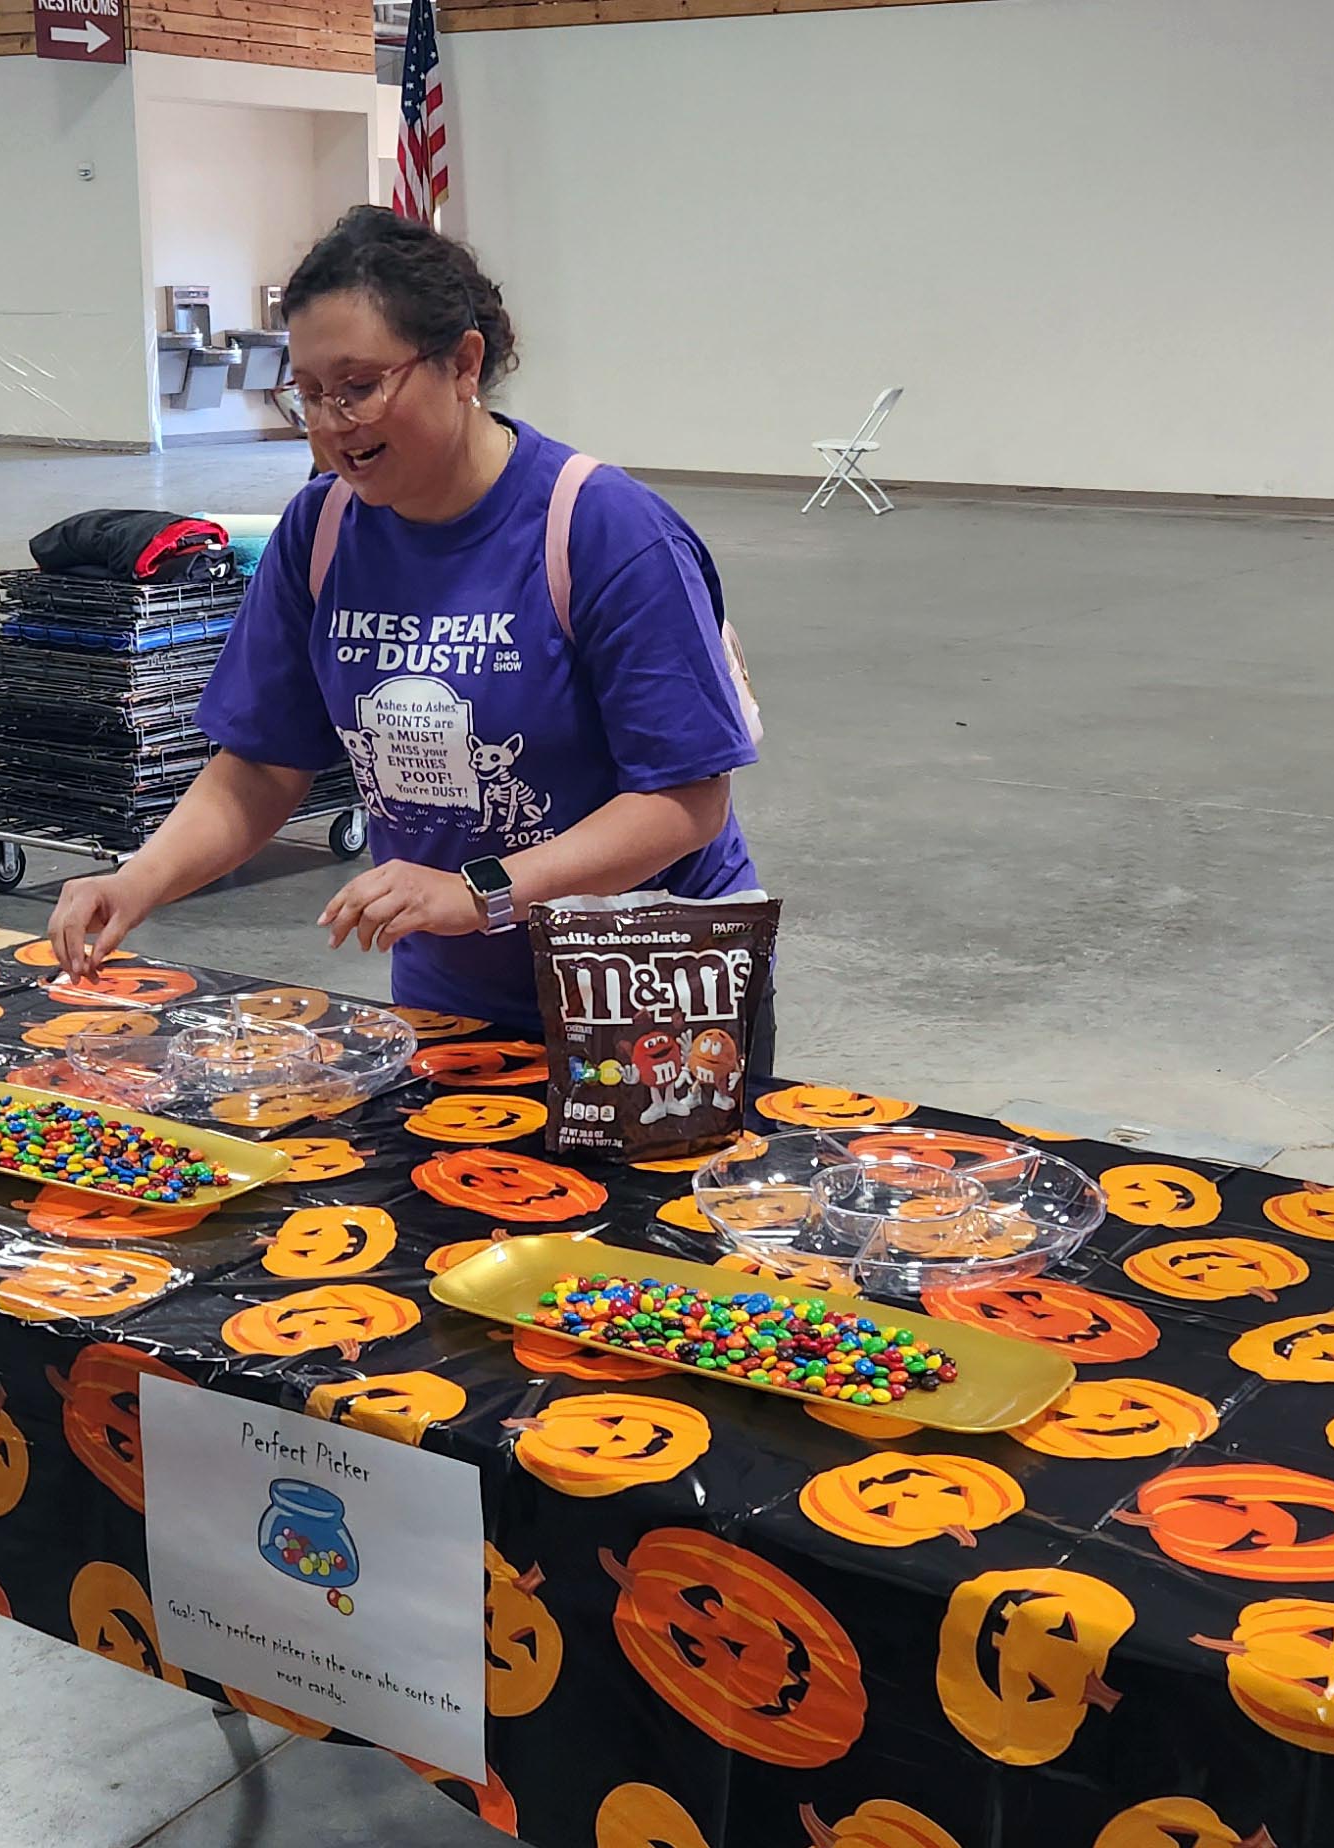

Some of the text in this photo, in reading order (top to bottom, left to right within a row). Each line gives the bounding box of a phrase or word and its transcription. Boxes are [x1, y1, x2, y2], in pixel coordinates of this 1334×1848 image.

[328, 609, 516, 645] IKES PEAK
[337, 642, 486, 675] or DUST!
[492, 661, 523, 672] SHOW
[375, 698, 459, 715] Ashes to Ashes,
[377, 713, 454, 729] POINTS are
[387, 729, 444, 745] a MUST!
[391, 743, 448, 758] MISS your
[387, 755, 447, 769] ENTRIES
[400, 770, 453, 785] POOF!
[395, 783, 468, 798] You're DUST!
[503, 827, 556, 848] 2025
[712, 922, 747, 935] PARTY
[549, 931, 692, 946] milk chocolate
[241, 1421, 370, 1482] Perfect Picker
[168, 1599, 462, 1714] Goal: The perfect picker is the one who sorts the
[276, 1670, 347, 1707] most candy.
